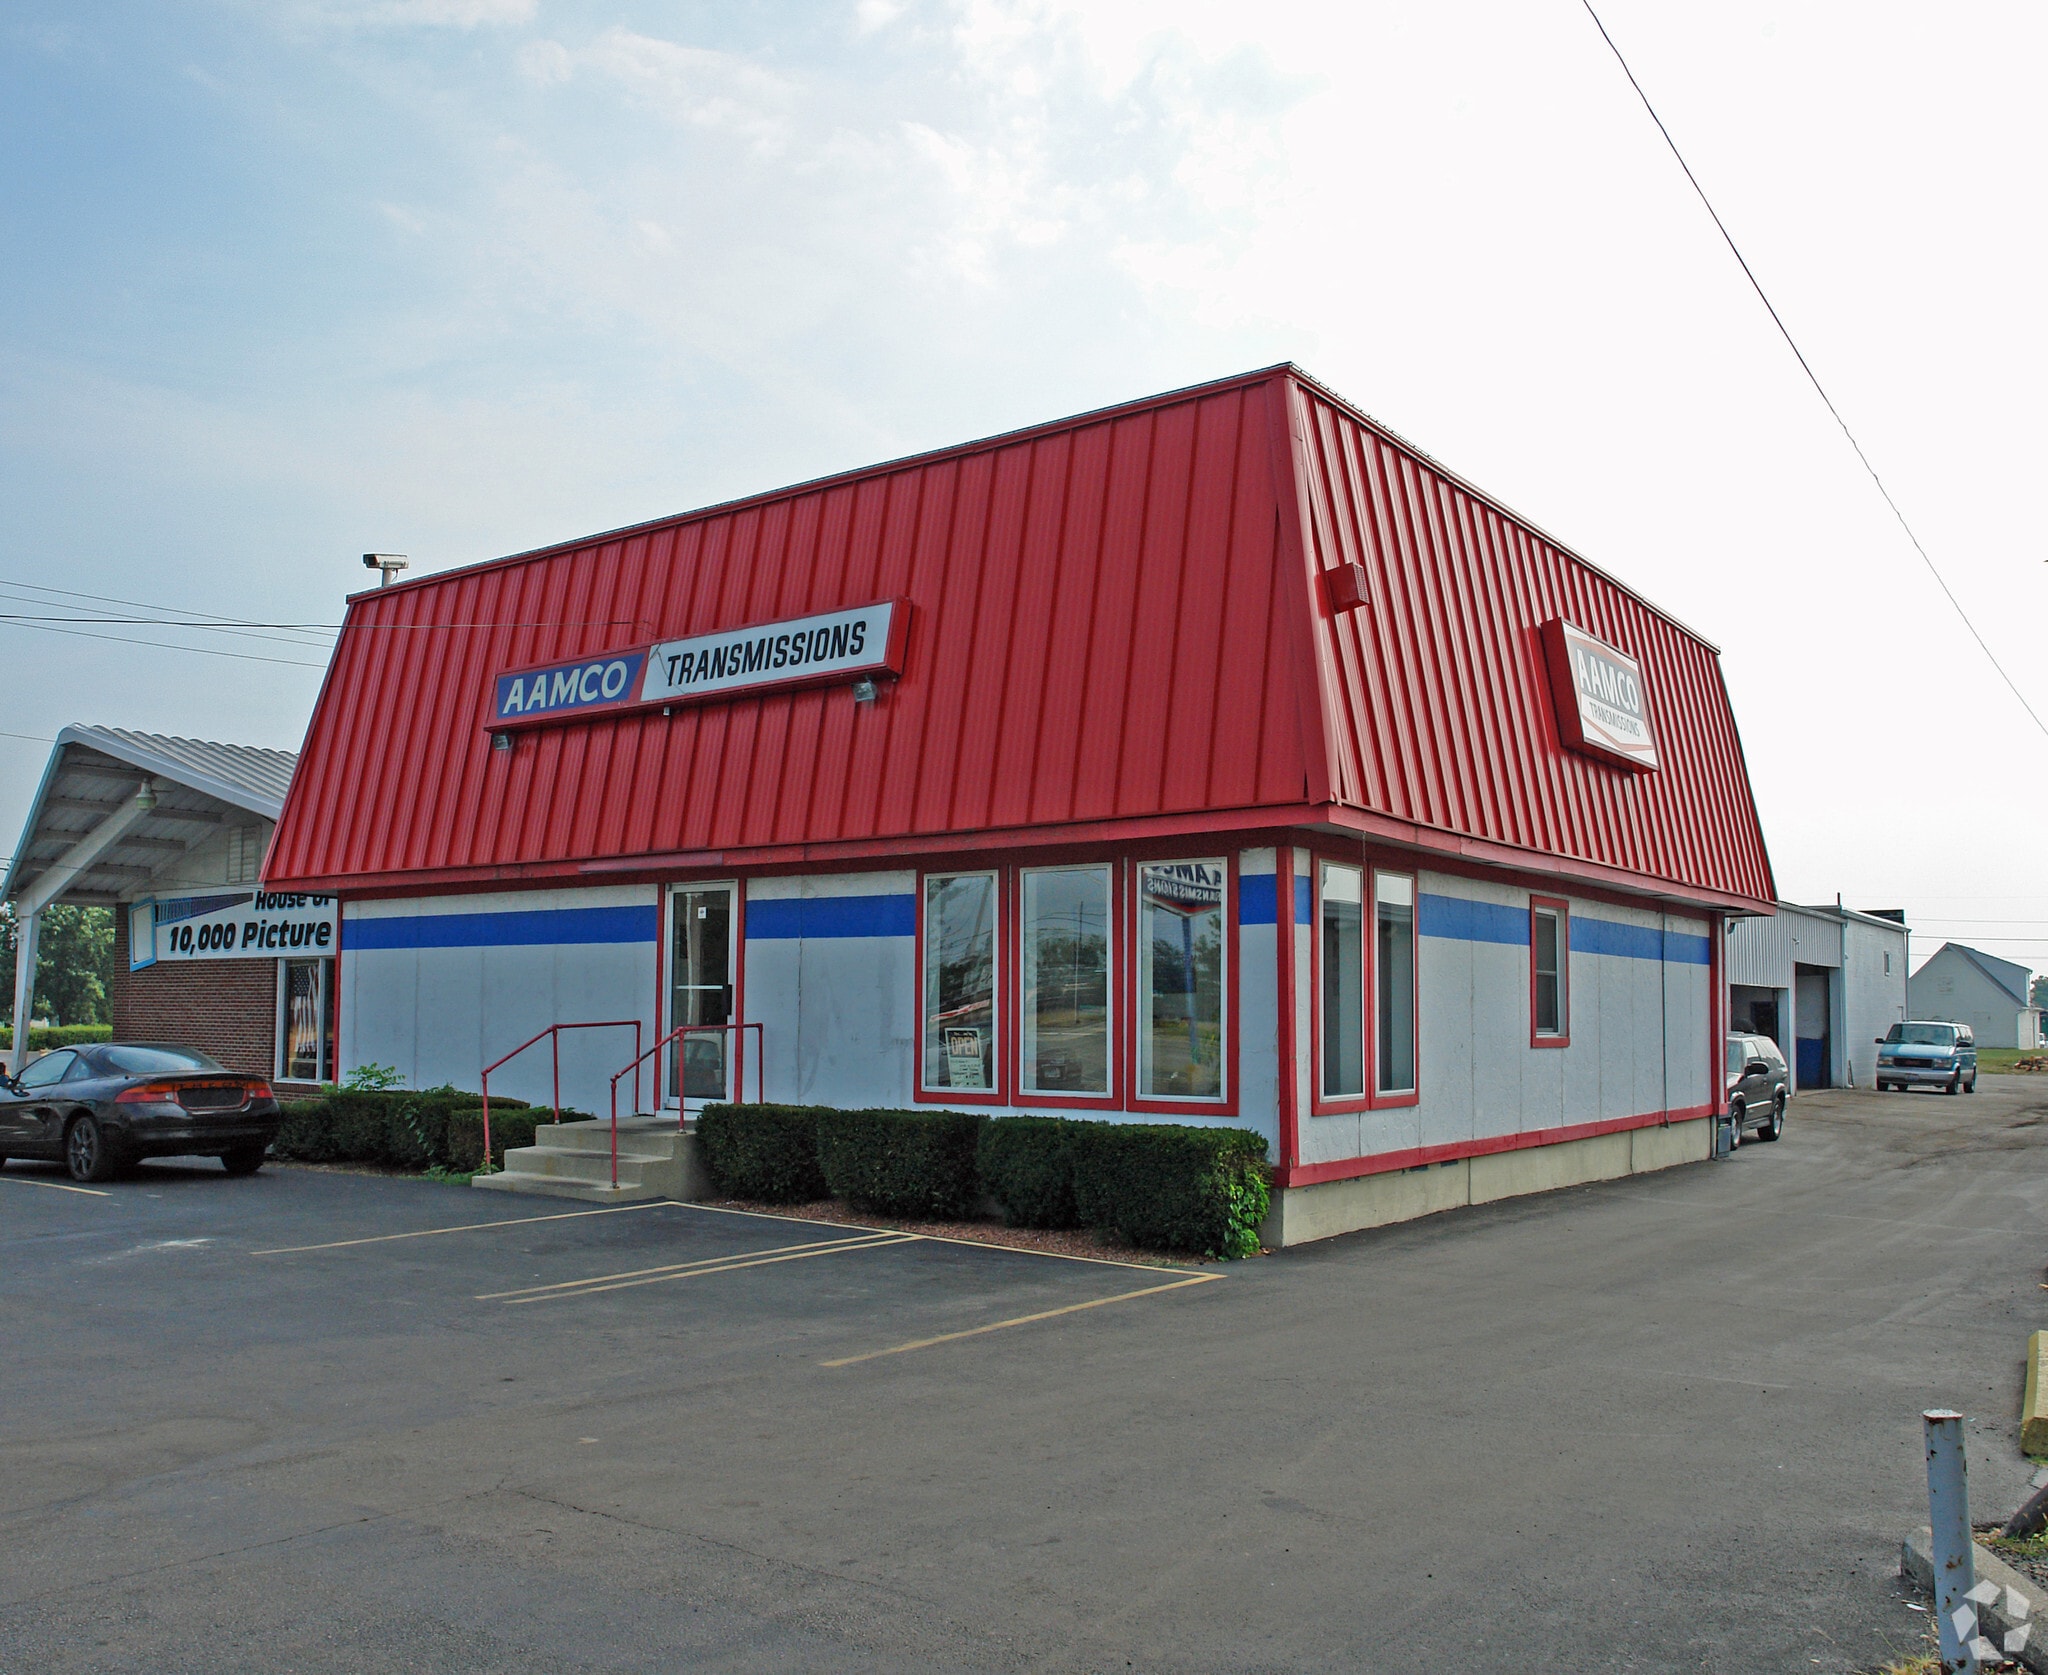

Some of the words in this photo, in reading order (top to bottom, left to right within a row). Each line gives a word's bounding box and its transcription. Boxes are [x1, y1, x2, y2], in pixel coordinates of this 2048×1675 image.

[503, 661, 627, 714] AAMCO
[668, 621, 866, 687] TRANSMISSIONS
[1577, 648, 1639, 714] AAMCO
[1589, 701, 1640, 737] TRANSMISSIONS
[255, 891, 306, 910] House
[170, 923, 236, 955] 10,000
[241, 919, 331, 948] Picture
[951, 1037, 979, 1056] OPEN
